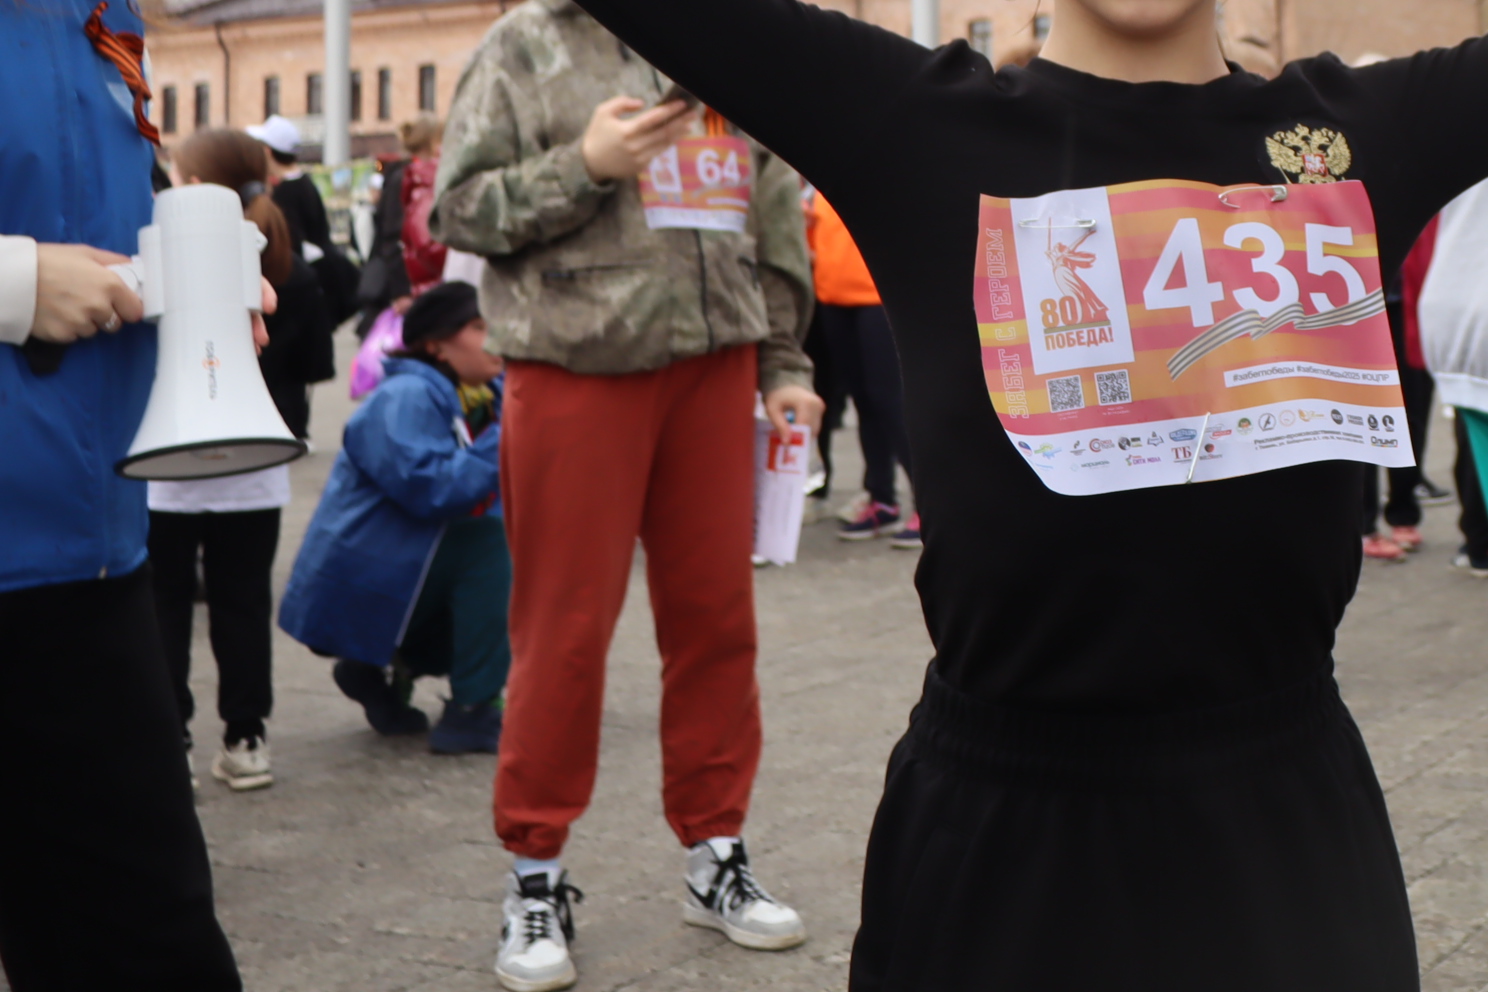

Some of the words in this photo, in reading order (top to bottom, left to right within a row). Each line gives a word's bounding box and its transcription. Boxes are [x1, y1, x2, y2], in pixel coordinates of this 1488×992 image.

[986, 227, 1014, 321] ГЕРОЕМ
[1143, 217, 1367, 328] 435
[995, 326, 1017, 342] С
[1040, 295, 1079, 329] 80
[1045, 327, 1114, 351] ПОБЕДА!
[998, 348, 1030, 419] ЗАБЕГ
